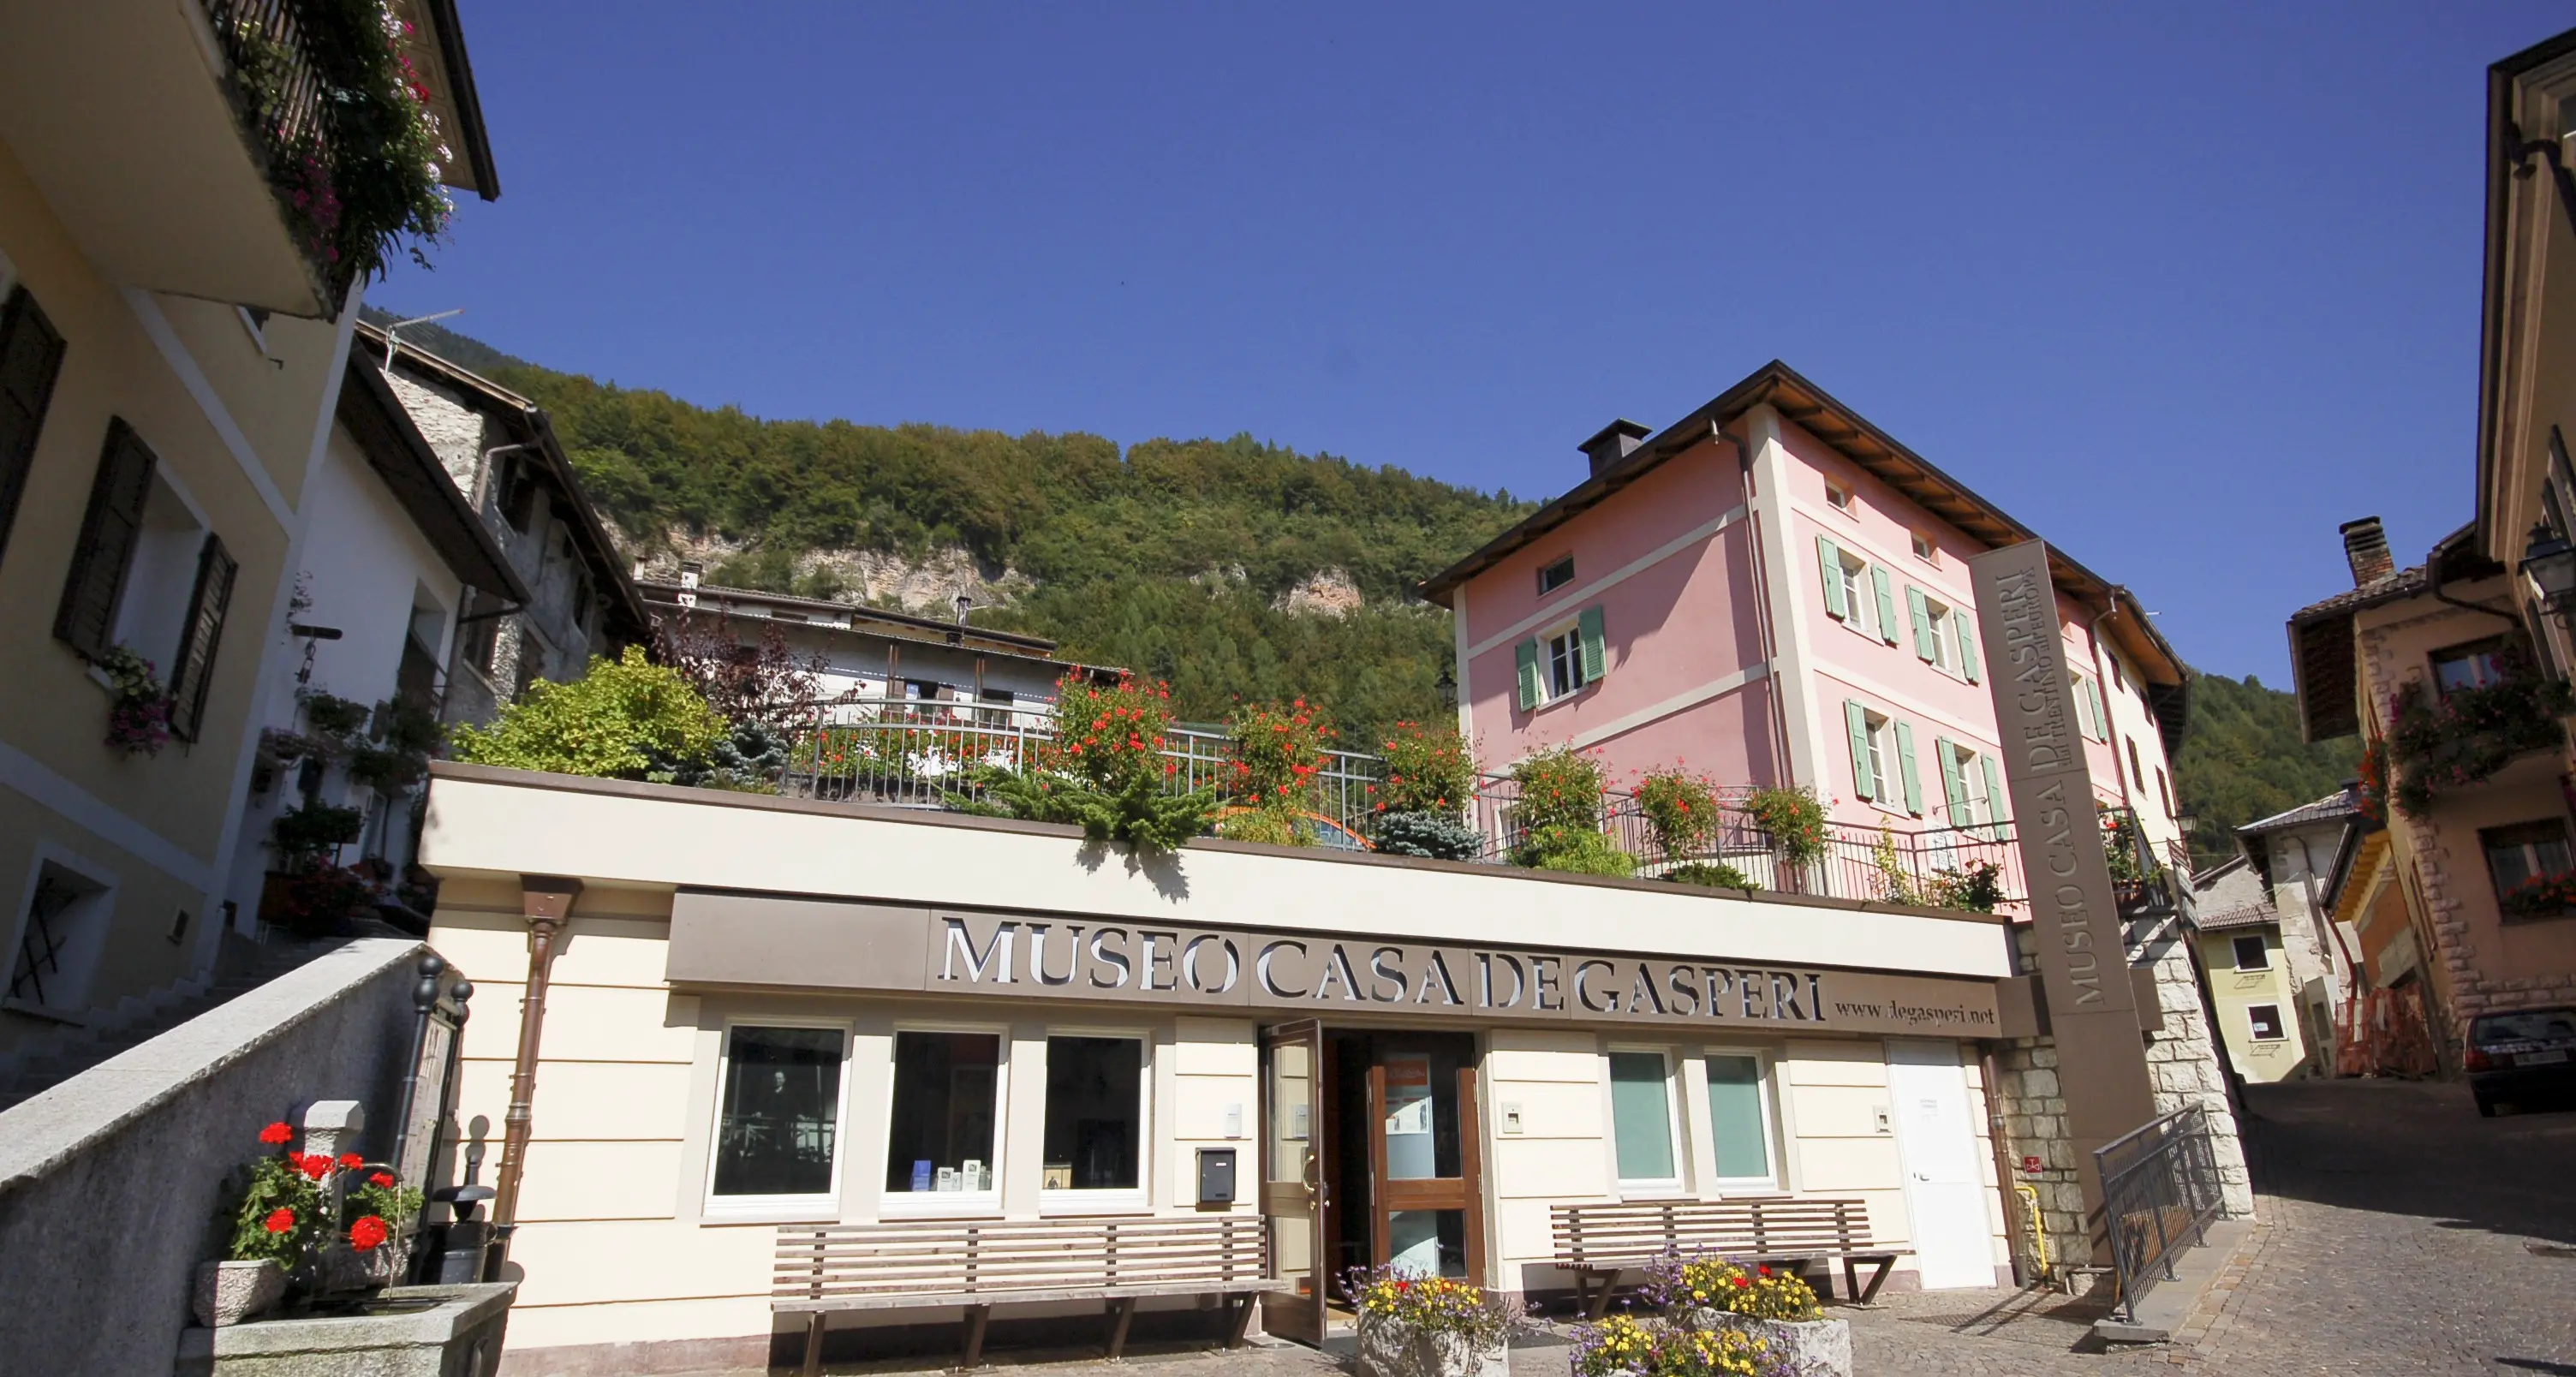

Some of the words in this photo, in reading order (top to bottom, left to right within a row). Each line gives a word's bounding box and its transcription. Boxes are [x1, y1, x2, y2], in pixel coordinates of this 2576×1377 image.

[1995, 569, 2048, 715] GASPERI
[2025, 726, 2061, 772] DE
[2036, 655, 2067, 742] TRENTINO
[2037, 779, 2078, 877] CASA
[937, 917, 1240, 993] MUSEO
[1256, 939, 1465, 1006] CASA
[1475, 951, 1565, 1011] DE
[1574, 959, 1827, 1022] GASPERI
[2054, 884, 2106, 1006] MUSEO
